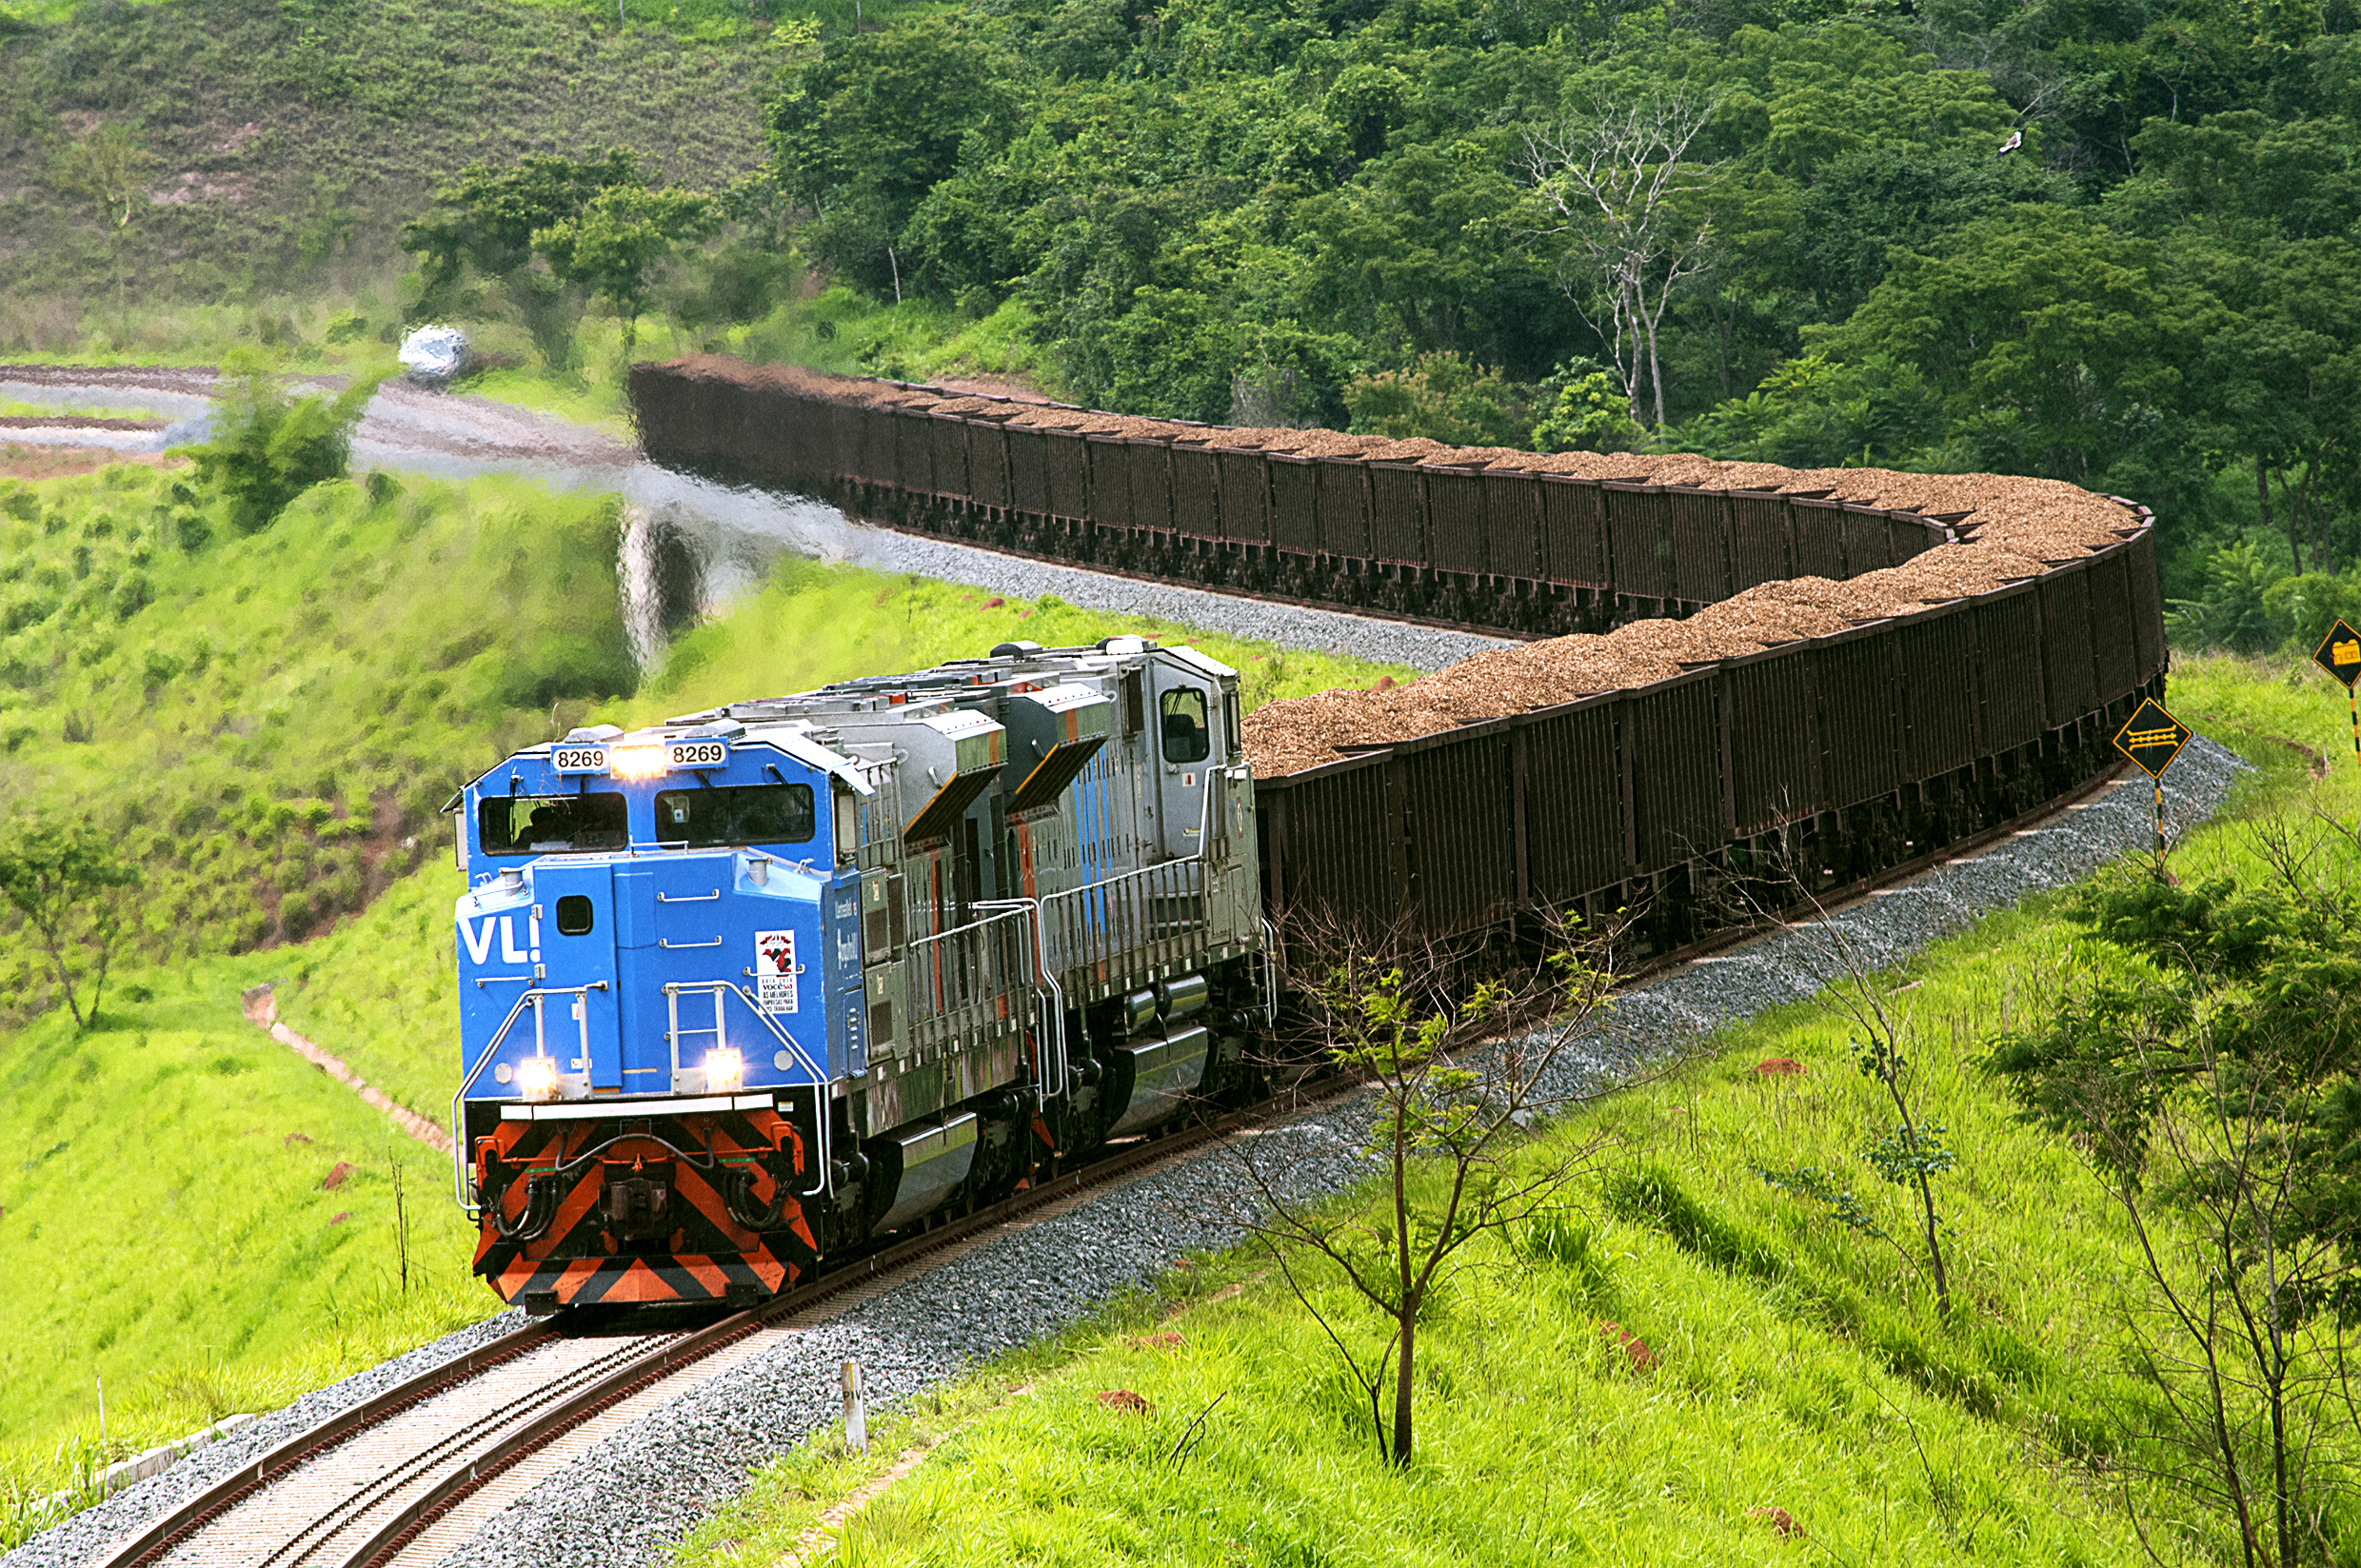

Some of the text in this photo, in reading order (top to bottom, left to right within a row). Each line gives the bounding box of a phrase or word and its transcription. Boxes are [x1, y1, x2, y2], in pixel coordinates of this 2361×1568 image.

[558, 750, 604, 768] 8269
[672, 744, 723, 764] 8269
[769, 990, 794, 999] MELHORES
